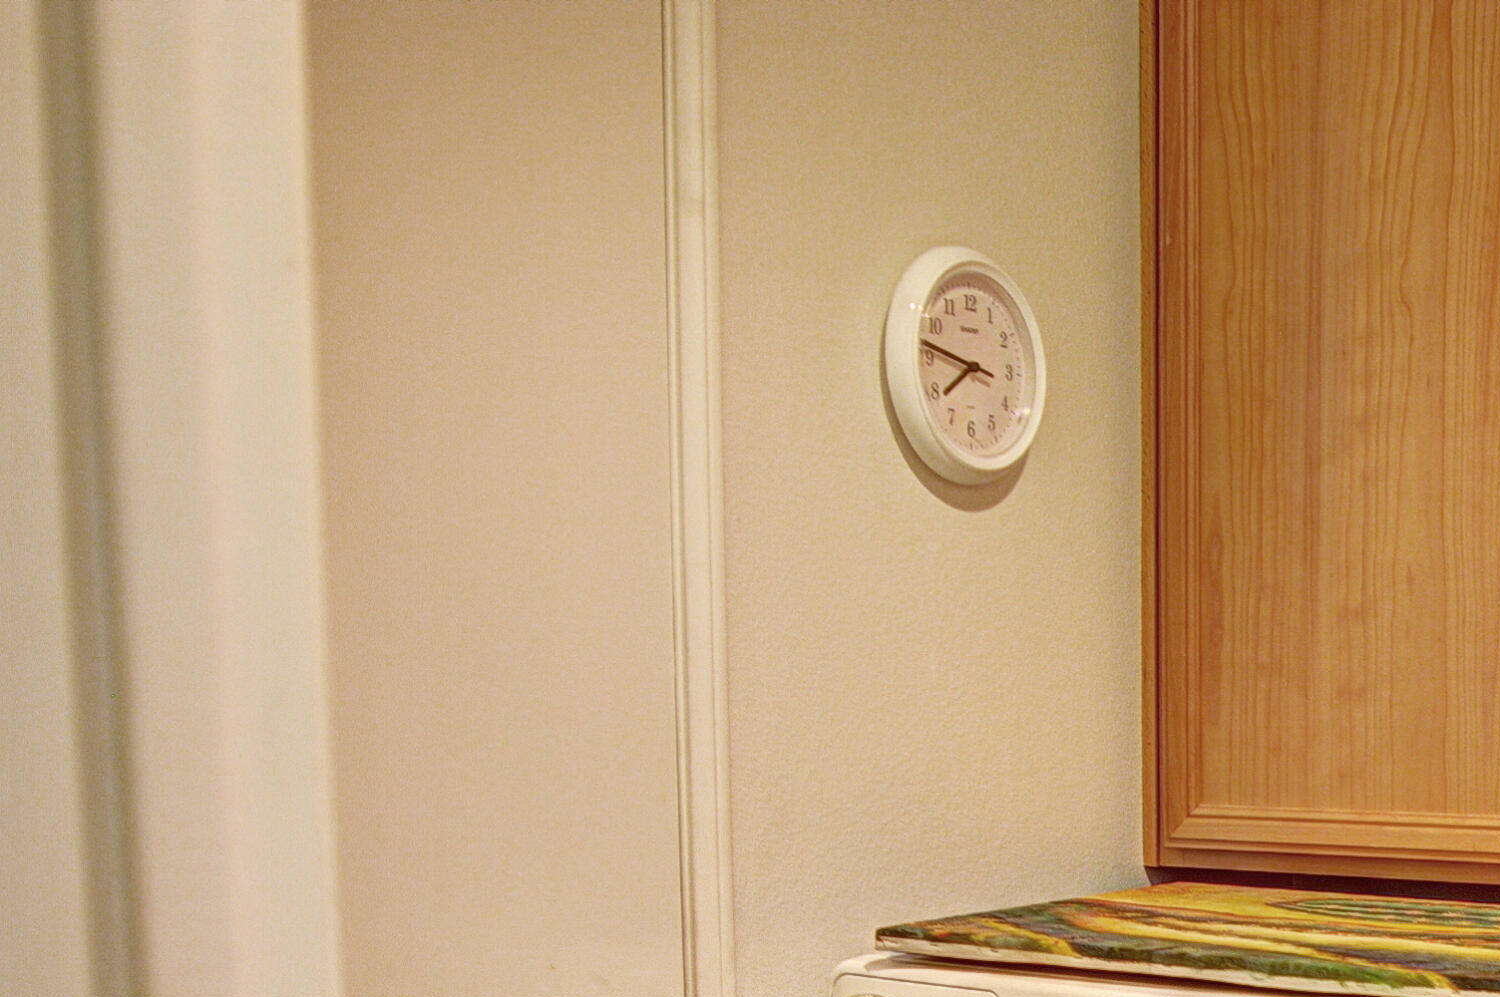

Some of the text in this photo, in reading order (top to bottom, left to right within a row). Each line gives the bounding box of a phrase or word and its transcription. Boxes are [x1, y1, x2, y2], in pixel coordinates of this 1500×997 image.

[944, 298, 956, 316] 11
[963, 294, 977, 313] 12
[986, 307, 994, 324] 1
[928, 317, 943, 335] 10
[999, 331, 1009, 349] 2
[925, 351, 934, 367] 9
[1005, 364, 1014, 381] 3
[931, 382, 940, 400] 8
[1001, 396, 1009, 411] 4
[947, 408, 955, 425] 7
[987, 414, 996, 432] 5
[967, 420, 976, 438] 6
